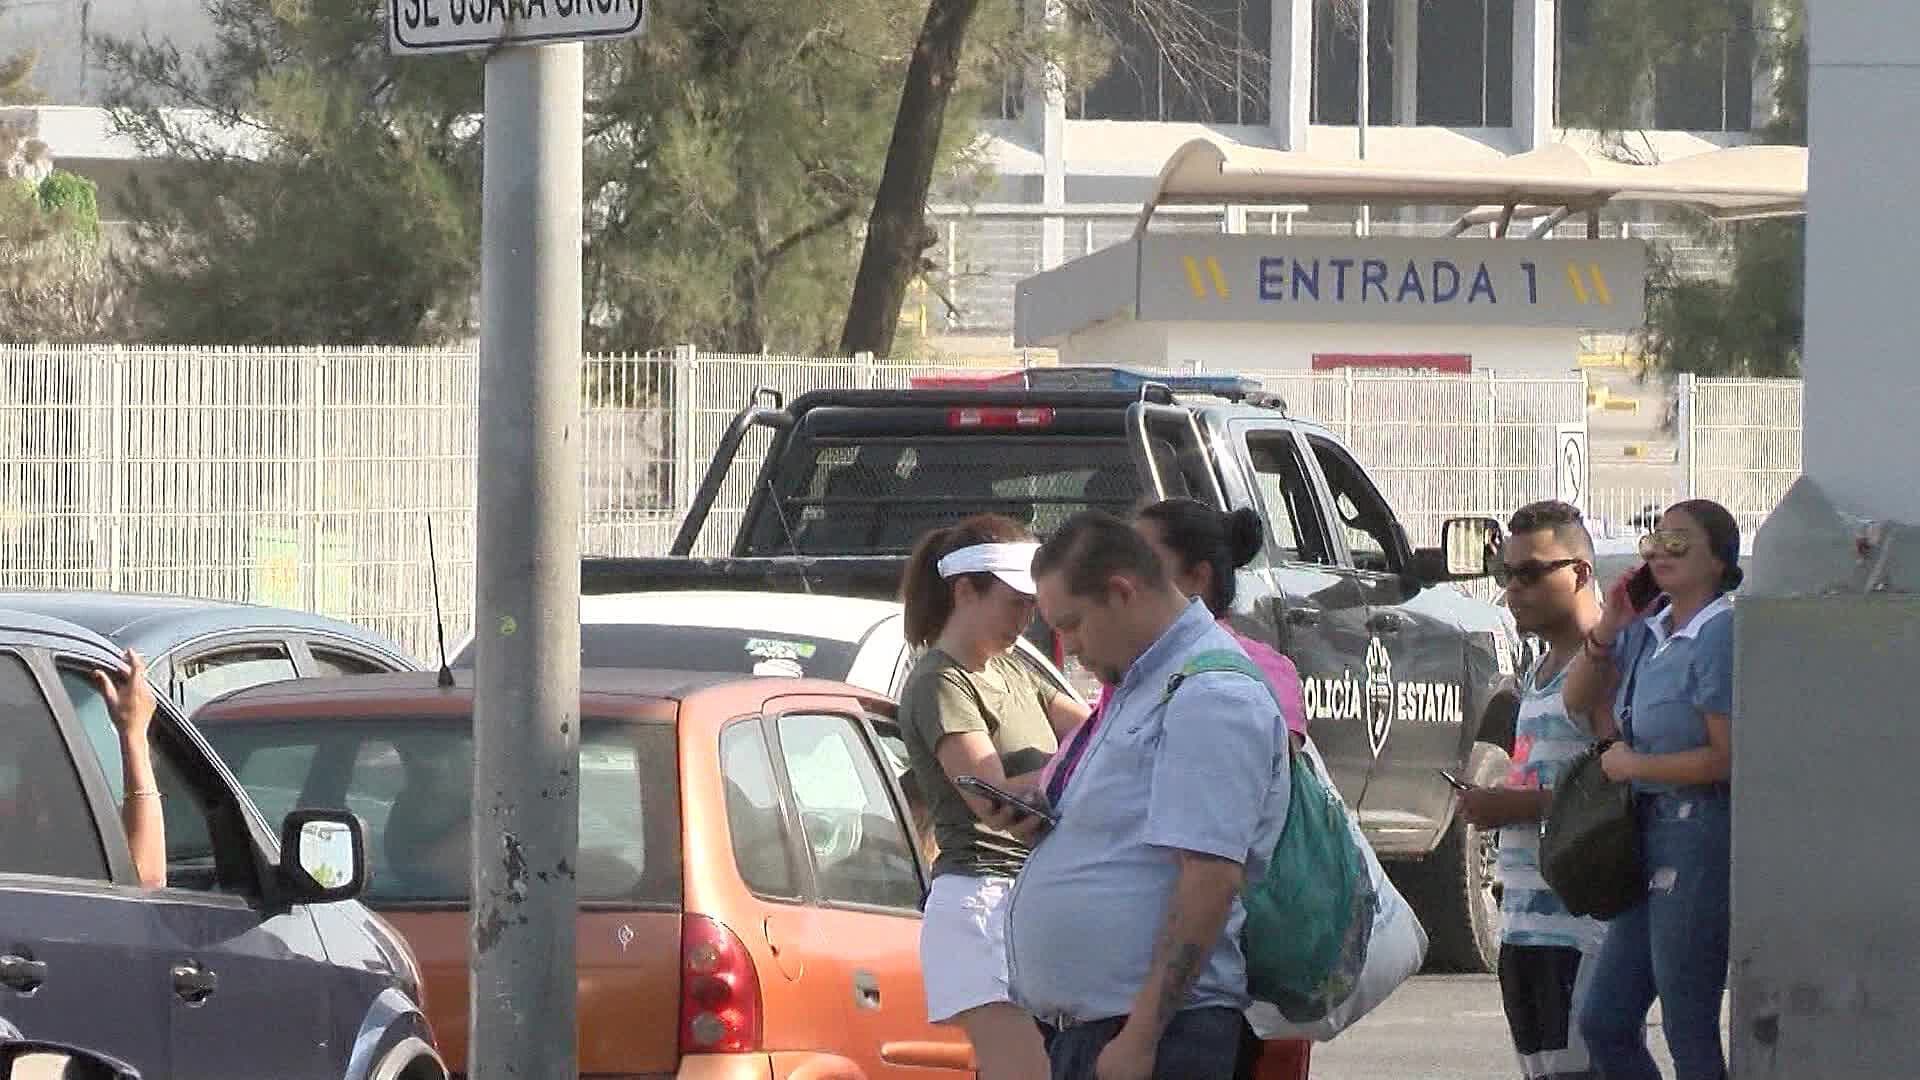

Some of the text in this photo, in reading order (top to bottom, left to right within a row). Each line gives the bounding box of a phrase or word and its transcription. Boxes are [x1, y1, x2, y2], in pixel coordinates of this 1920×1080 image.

[1259, 257, 1537, 304] ENTRADA 1
[1299, 669, 1464, 722] OLICÍA ESTATAL
